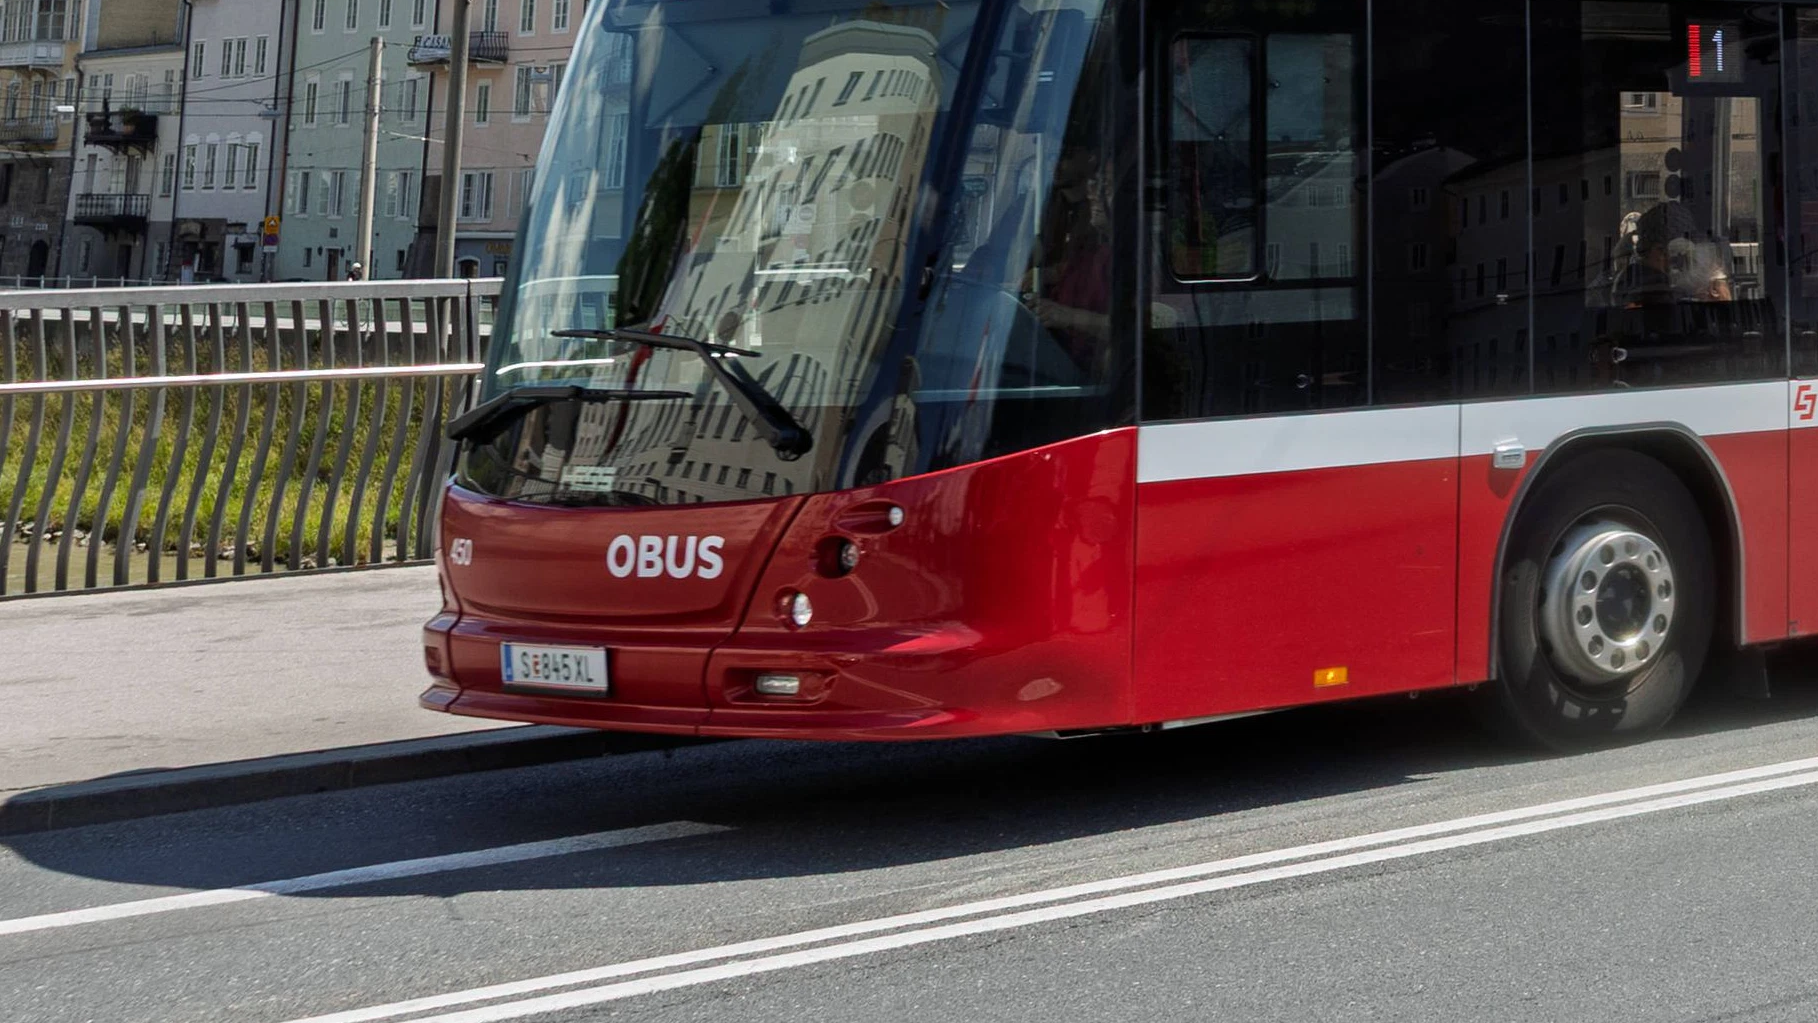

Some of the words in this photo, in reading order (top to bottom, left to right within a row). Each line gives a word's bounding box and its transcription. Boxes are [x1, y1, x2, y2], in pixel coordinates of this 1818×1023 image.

[1711, 30, 1724, 71] 1
[450, 538, 473, 566] 450
[606, 534, 726, 579] OBUS
